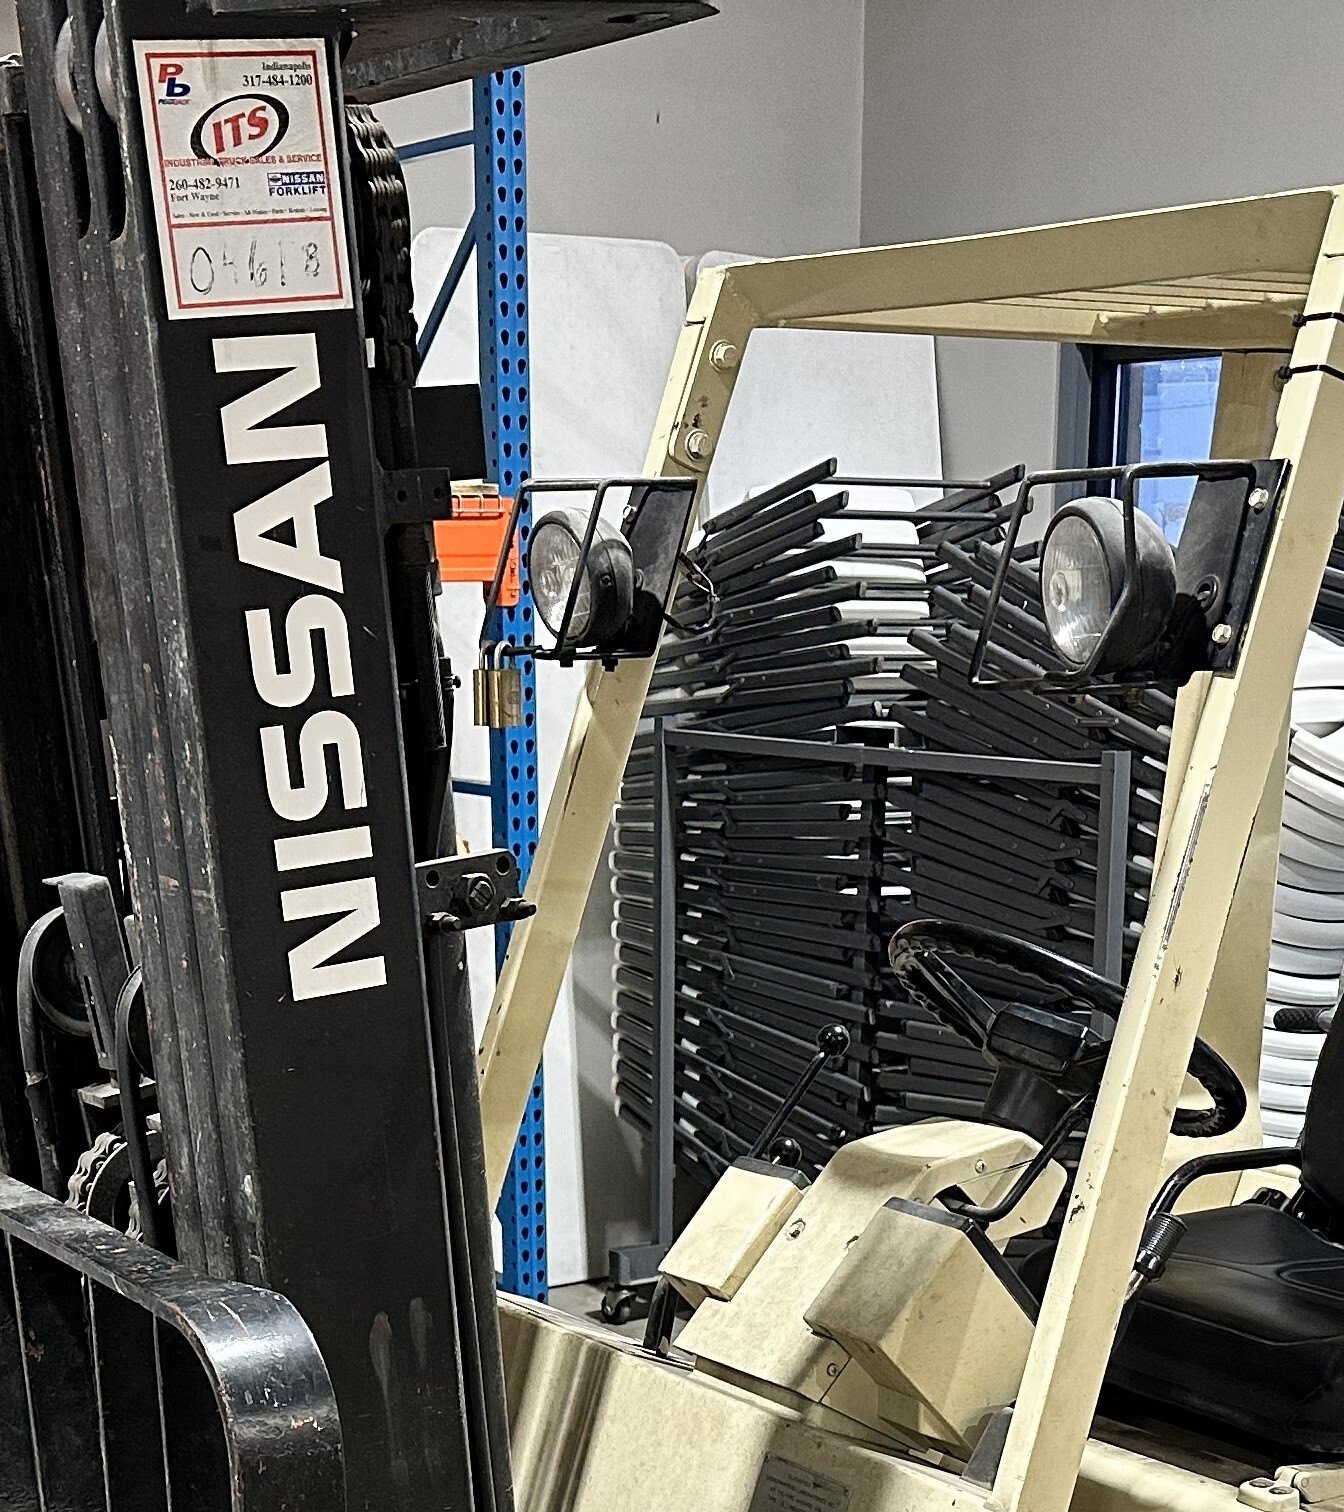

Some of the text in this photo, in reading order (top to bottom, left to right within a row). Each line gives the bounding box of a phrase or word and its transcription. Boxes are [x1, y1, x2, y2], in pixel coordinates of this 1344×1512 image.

[242, 74, 313, 88] 317-484-1200
[212, 105, 270, 154] ITS
[250, 155, 277, 165] SALES
[286, 153, 323, 164] SERVICE
[168, 176, 241, 191] 260-482-9471
[282, 174, 325, 184] NISSAN
[170, 191, 220, 203] Fort Wayne
[268, 184, 327, 197] FORKLIFT
[212, 333, 388, 1002] NISSAN
